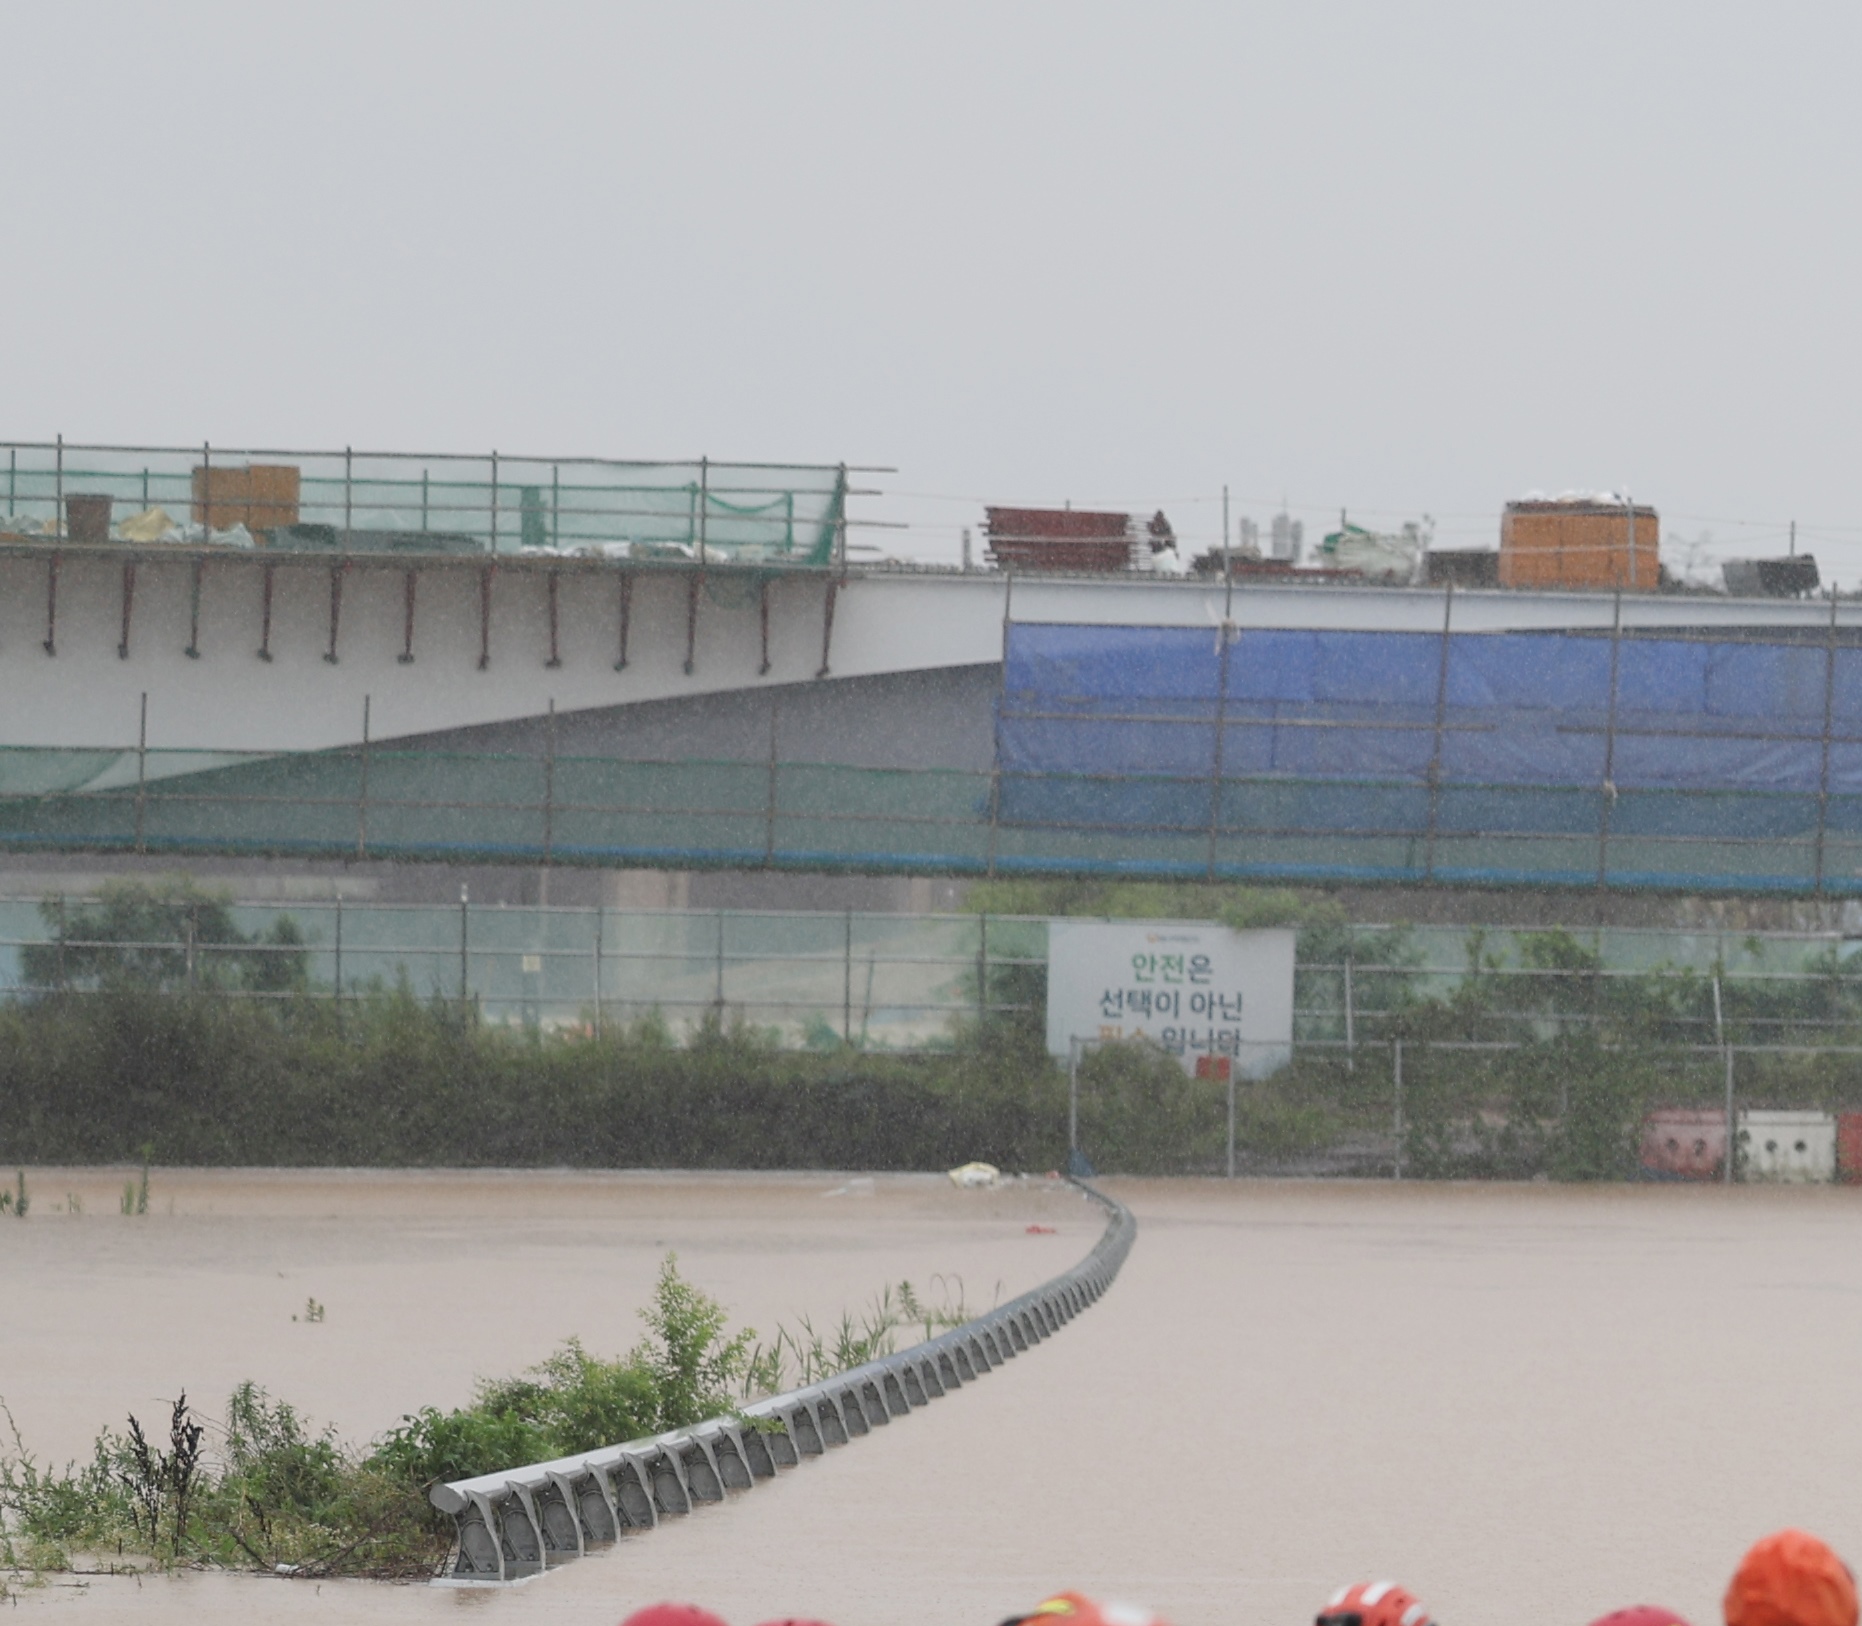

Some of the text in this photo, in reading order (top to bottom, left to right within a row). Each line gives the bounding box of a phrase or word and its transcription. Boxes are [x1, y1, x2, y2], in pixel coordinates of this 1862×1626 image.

[1131, 953, 1213, 984] 안전은
[1099, 988, 1243, 1021] 선택이 아닌
